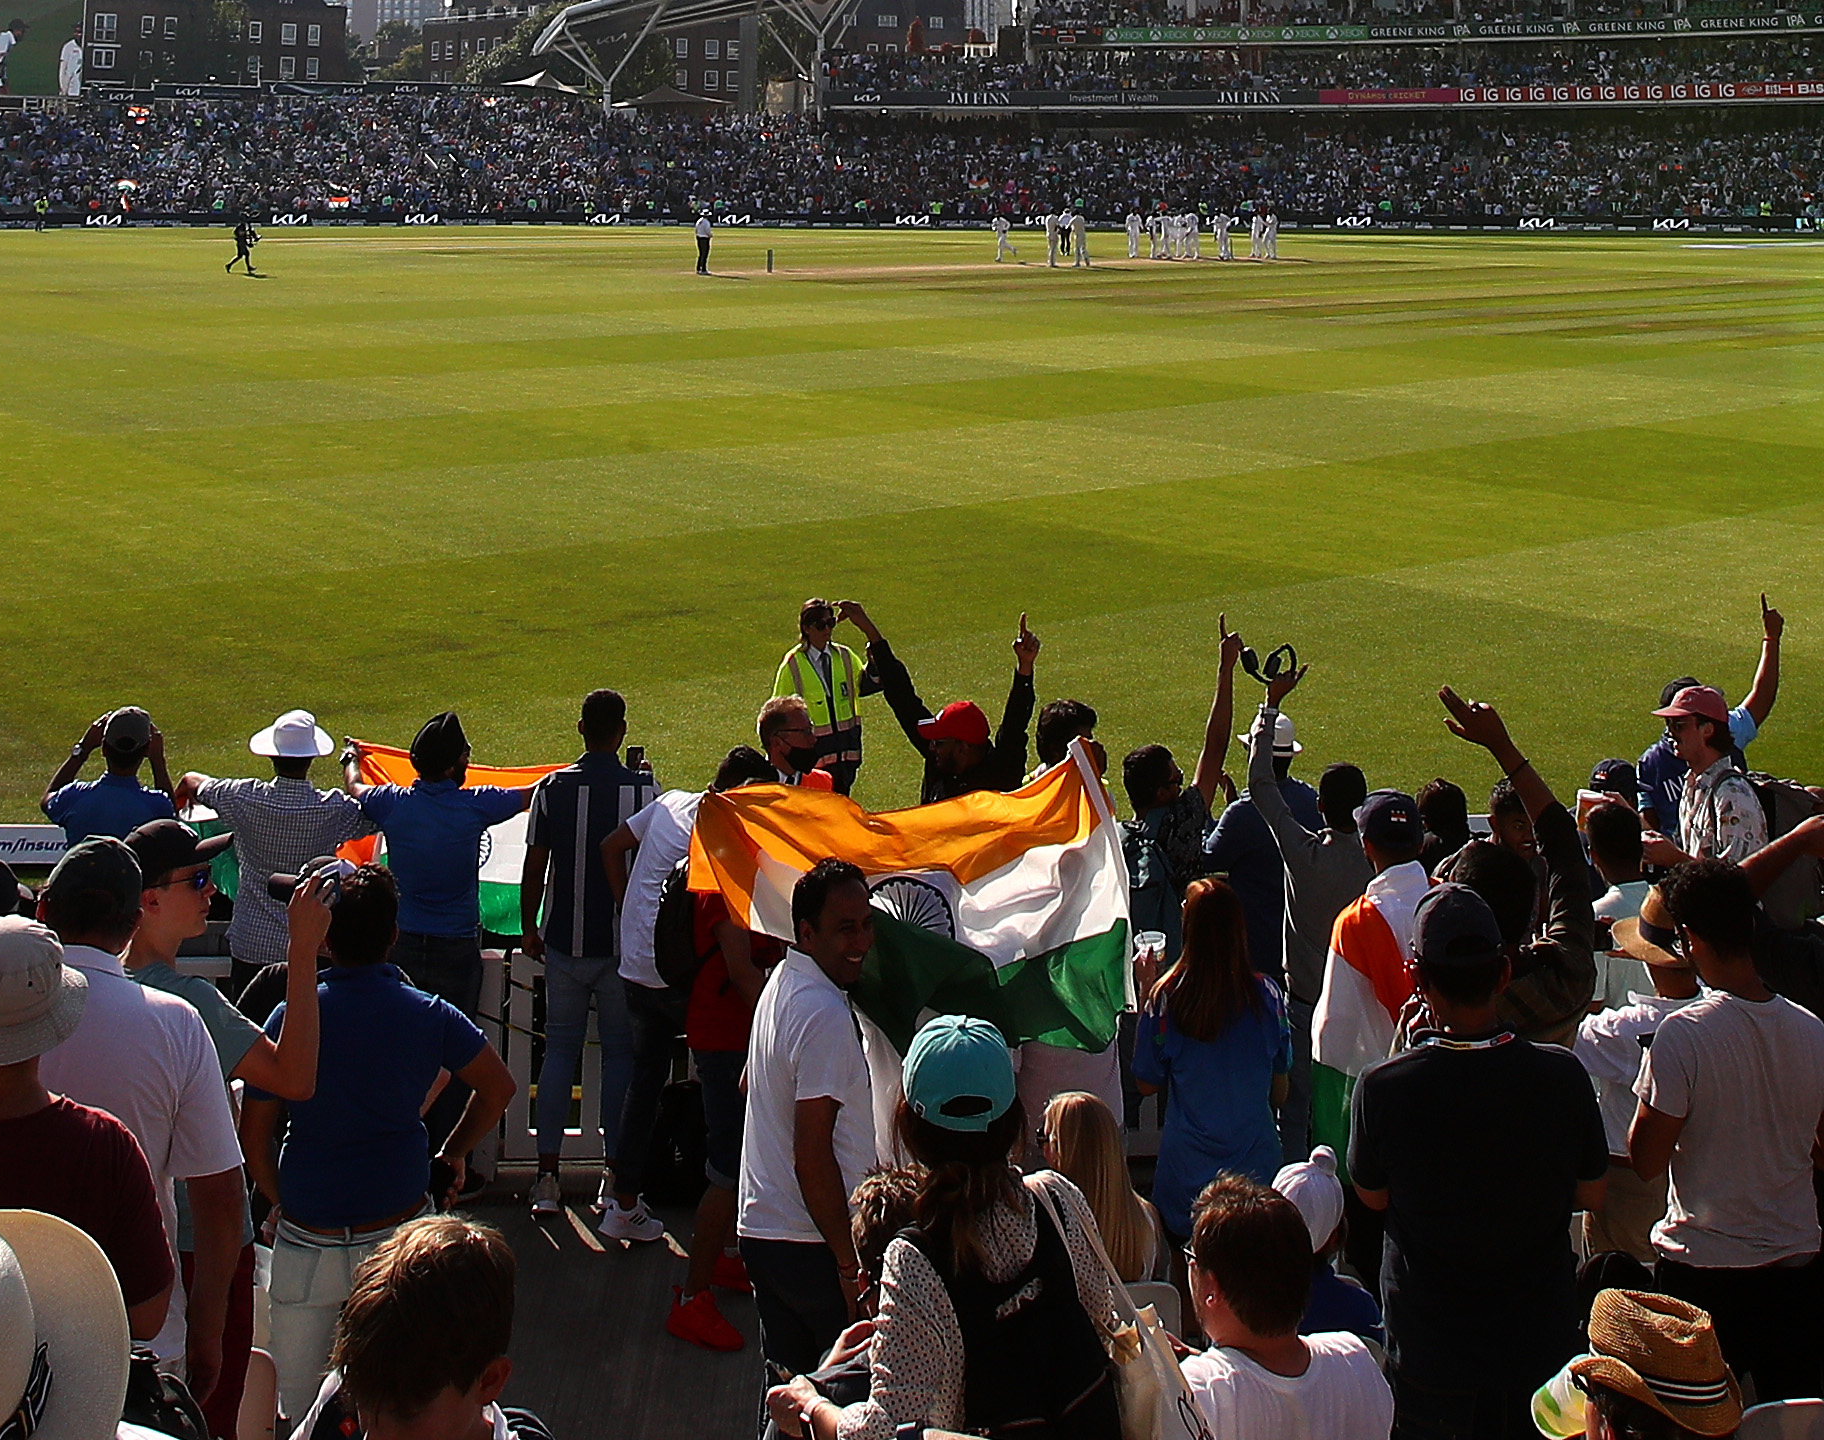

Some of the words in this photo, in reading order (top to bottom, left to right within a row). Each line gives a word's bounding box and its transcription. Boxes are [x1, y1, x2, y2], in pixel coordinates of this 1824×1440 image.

[1589, 21, 1633, 33] GREENE
[1636, 20, 1666, 31] KING
[1673, 18, 1692, 32] IPA
[1700, 18, 1746, 29] GREENE
[1749, 17, 1779, 27] KING
[1786, 14, 1805, 28] IPA
[1119, 29, 1144, 39] XBOX
[1294, 28, 1320, 39] XBOX
[1339, 28, 1364, 38] XBOX
[1371, 26, 1413, 37] GREENE
[1417, 26, 1446, 36] KING
[1452, 24, 1471, 38] IPA
[1479, 23, 1523, 35] GREENE
[1526, 23, 1554, 34] KING
[1562, 22, 1581, 35] IPA
[1162, 29, 1188, 40] XBOX
[1206, 29, 1232, 40] XBOX
[1250, 29, 1276, 40] XBOX
[1670, 84, 1687, 98] IG
[1694, 84, 1711, 97] IG
[1719, 83, 1735, 97] IG
[947, 92, 973, 104] JM
[975, 92, 1010, 105] FINN
[1069, 92, 1119, 103] Investment
[1128, 92, 1159, 102] Wealth
[1217, 91, 1242, 104] JM
[1243, 91, 1280, 104] FINN
[896, 215, 930, 224] KIA
